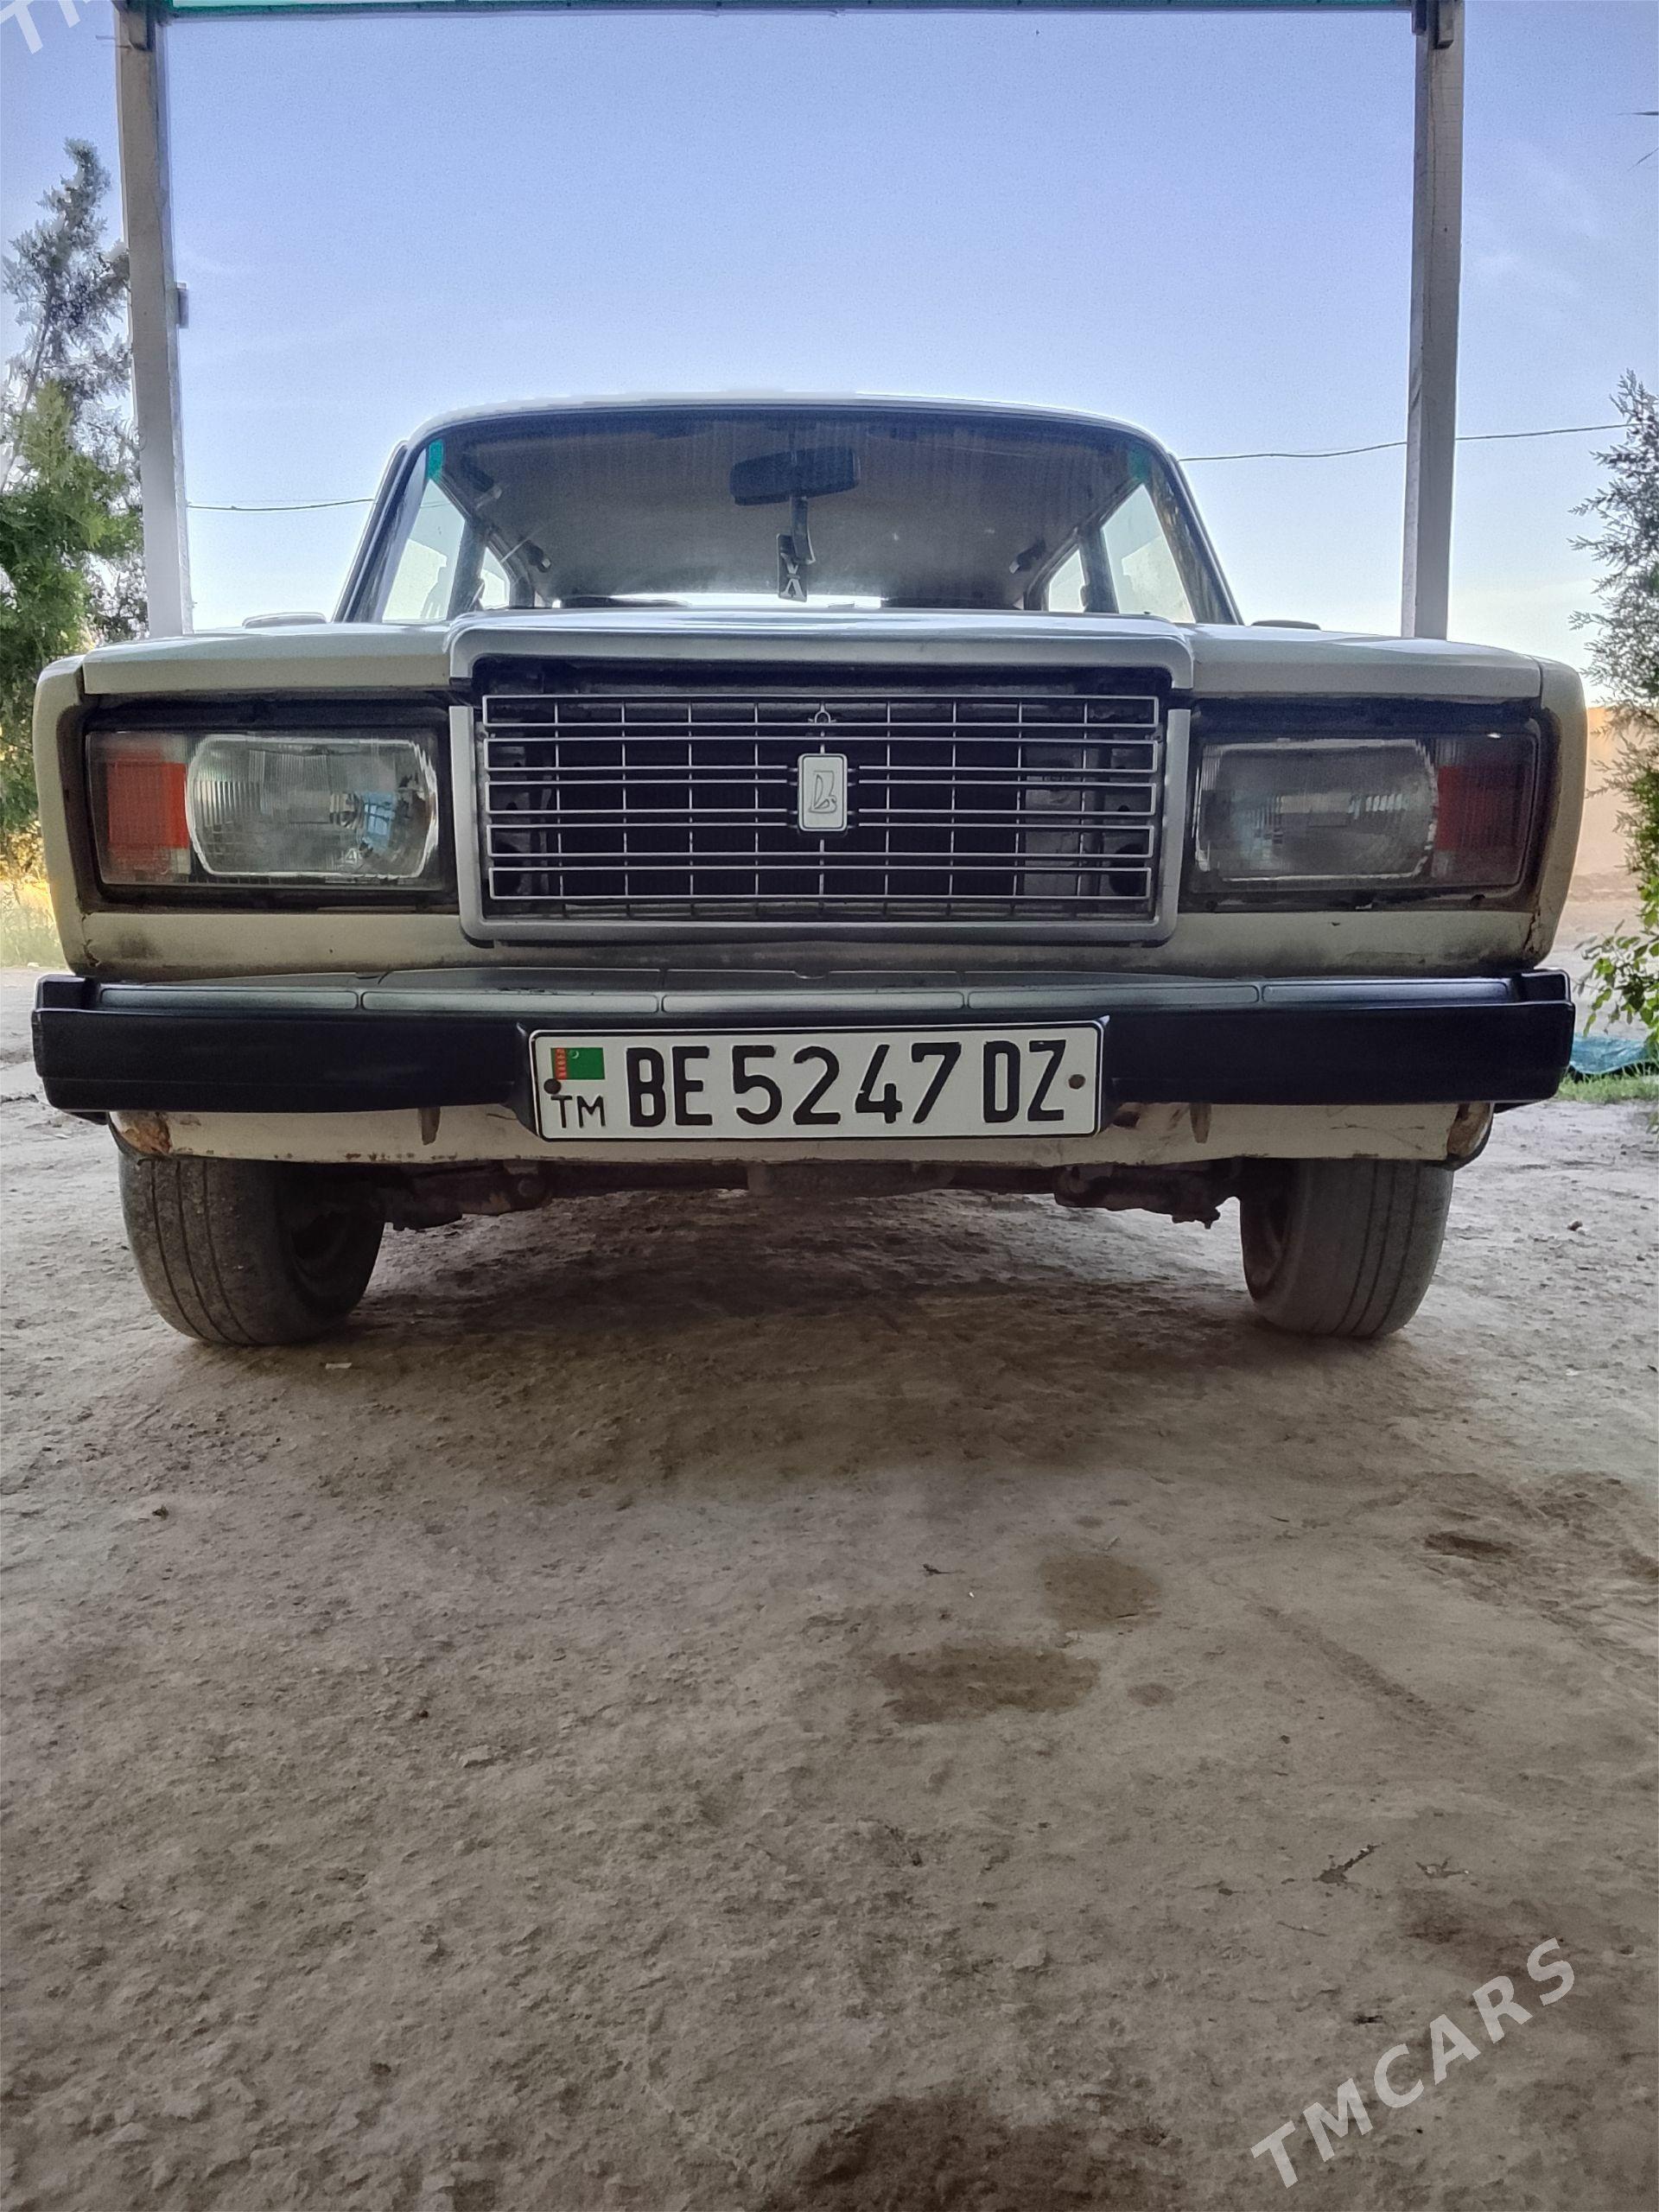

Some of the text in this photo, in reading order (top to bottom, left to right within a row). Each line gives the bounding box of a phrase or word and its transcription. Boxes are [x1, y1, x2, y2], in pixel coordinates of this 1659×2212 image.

[551, 1094, 607, 1128] TM
[626, 1039, 1067, 1127] BE 5247 DZ
